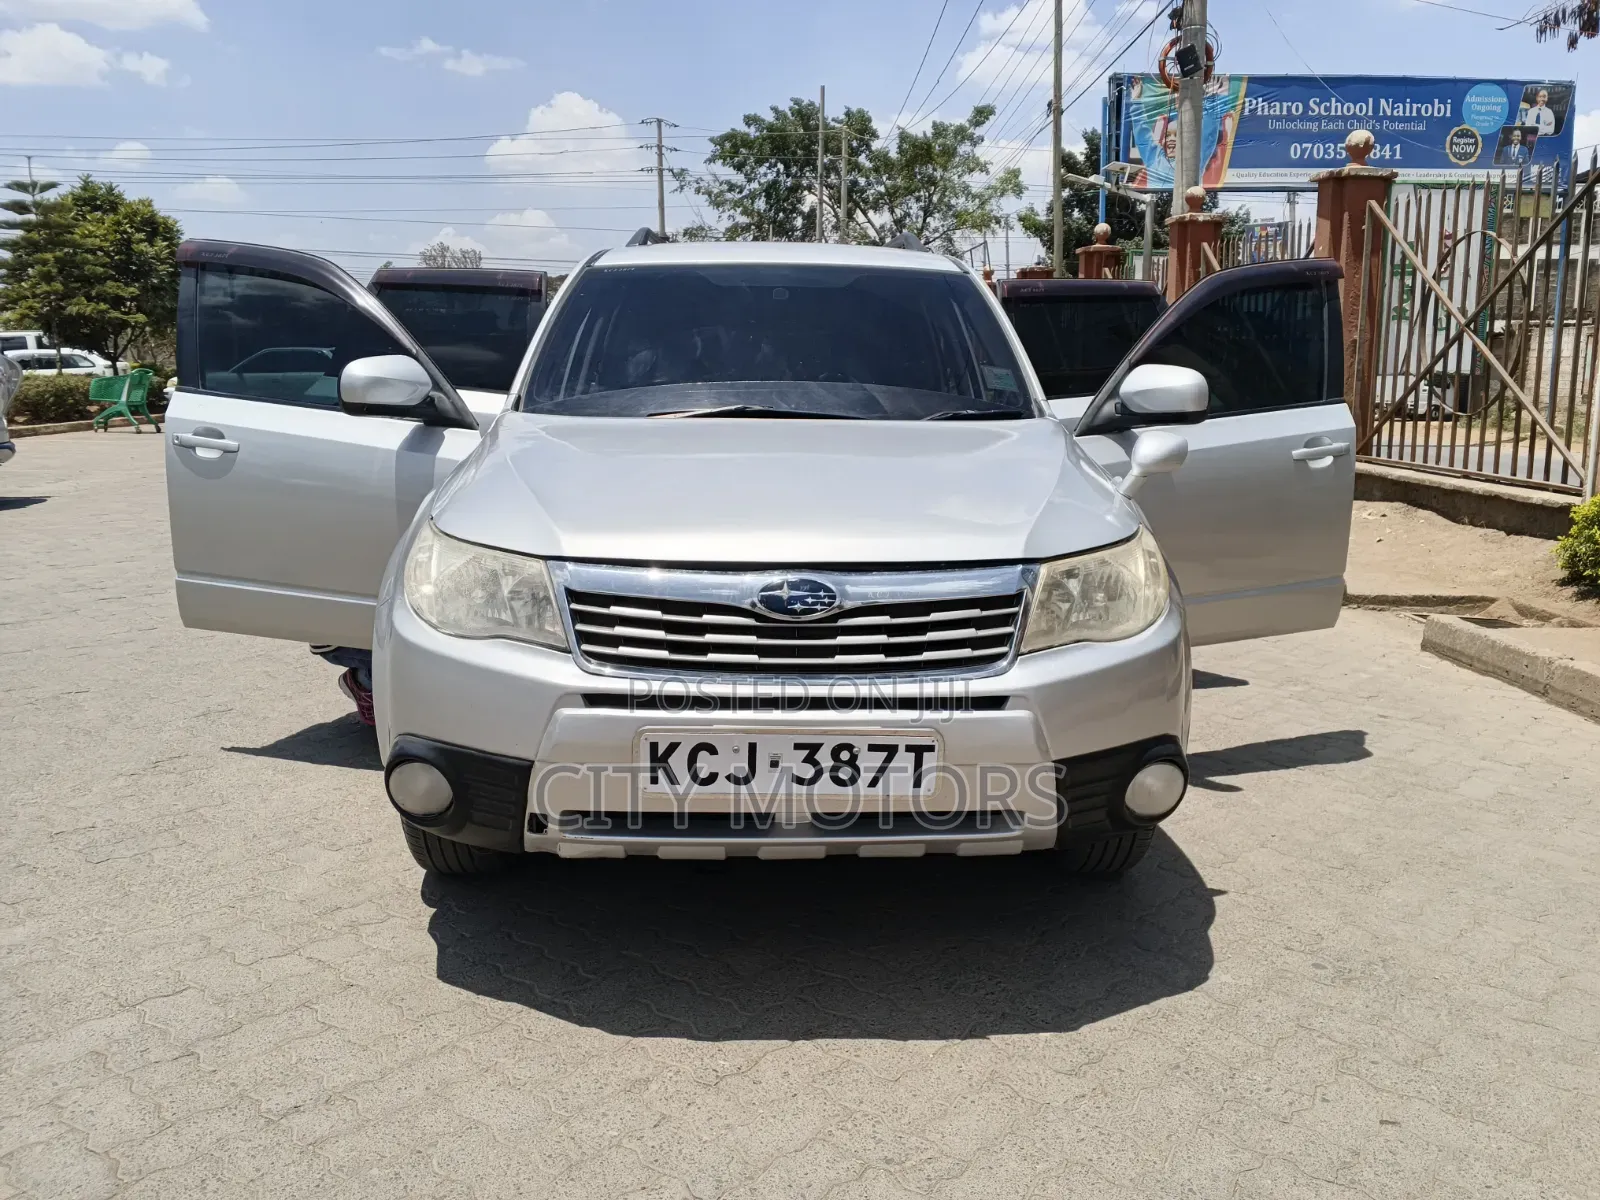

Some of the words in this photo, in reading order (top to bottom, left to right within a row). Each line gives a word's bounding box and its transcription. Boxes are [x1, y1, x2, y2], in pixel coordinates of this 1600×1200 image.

[1465, 95, 1507, 103] Admissions
[1243, 97, 1303, 116] Pharo
[1308, 97, 1373, 116] School
[1379, 98, 1452, 117] Nairobi
[1471, 103, 1502, 113] Ongoing
[1268, 119, 1319, 132] Unlocking
[1321, 119, 1345, 130] Each
[1347, 119, 1380, 130] Child's
[1383, 120, 1426, 131] Potential
[1452, 136, 1476, 144] Register
[1290, 142, 1402, 159] 07035841
[1452, 144, 1476, 154] NOW
[1236, 171, 1257, 179] Quality
[1289, 171, 1311, 179] Experie
[648, 741, 758, 786] KCJ
[791, 742, 936, 788] 387T
